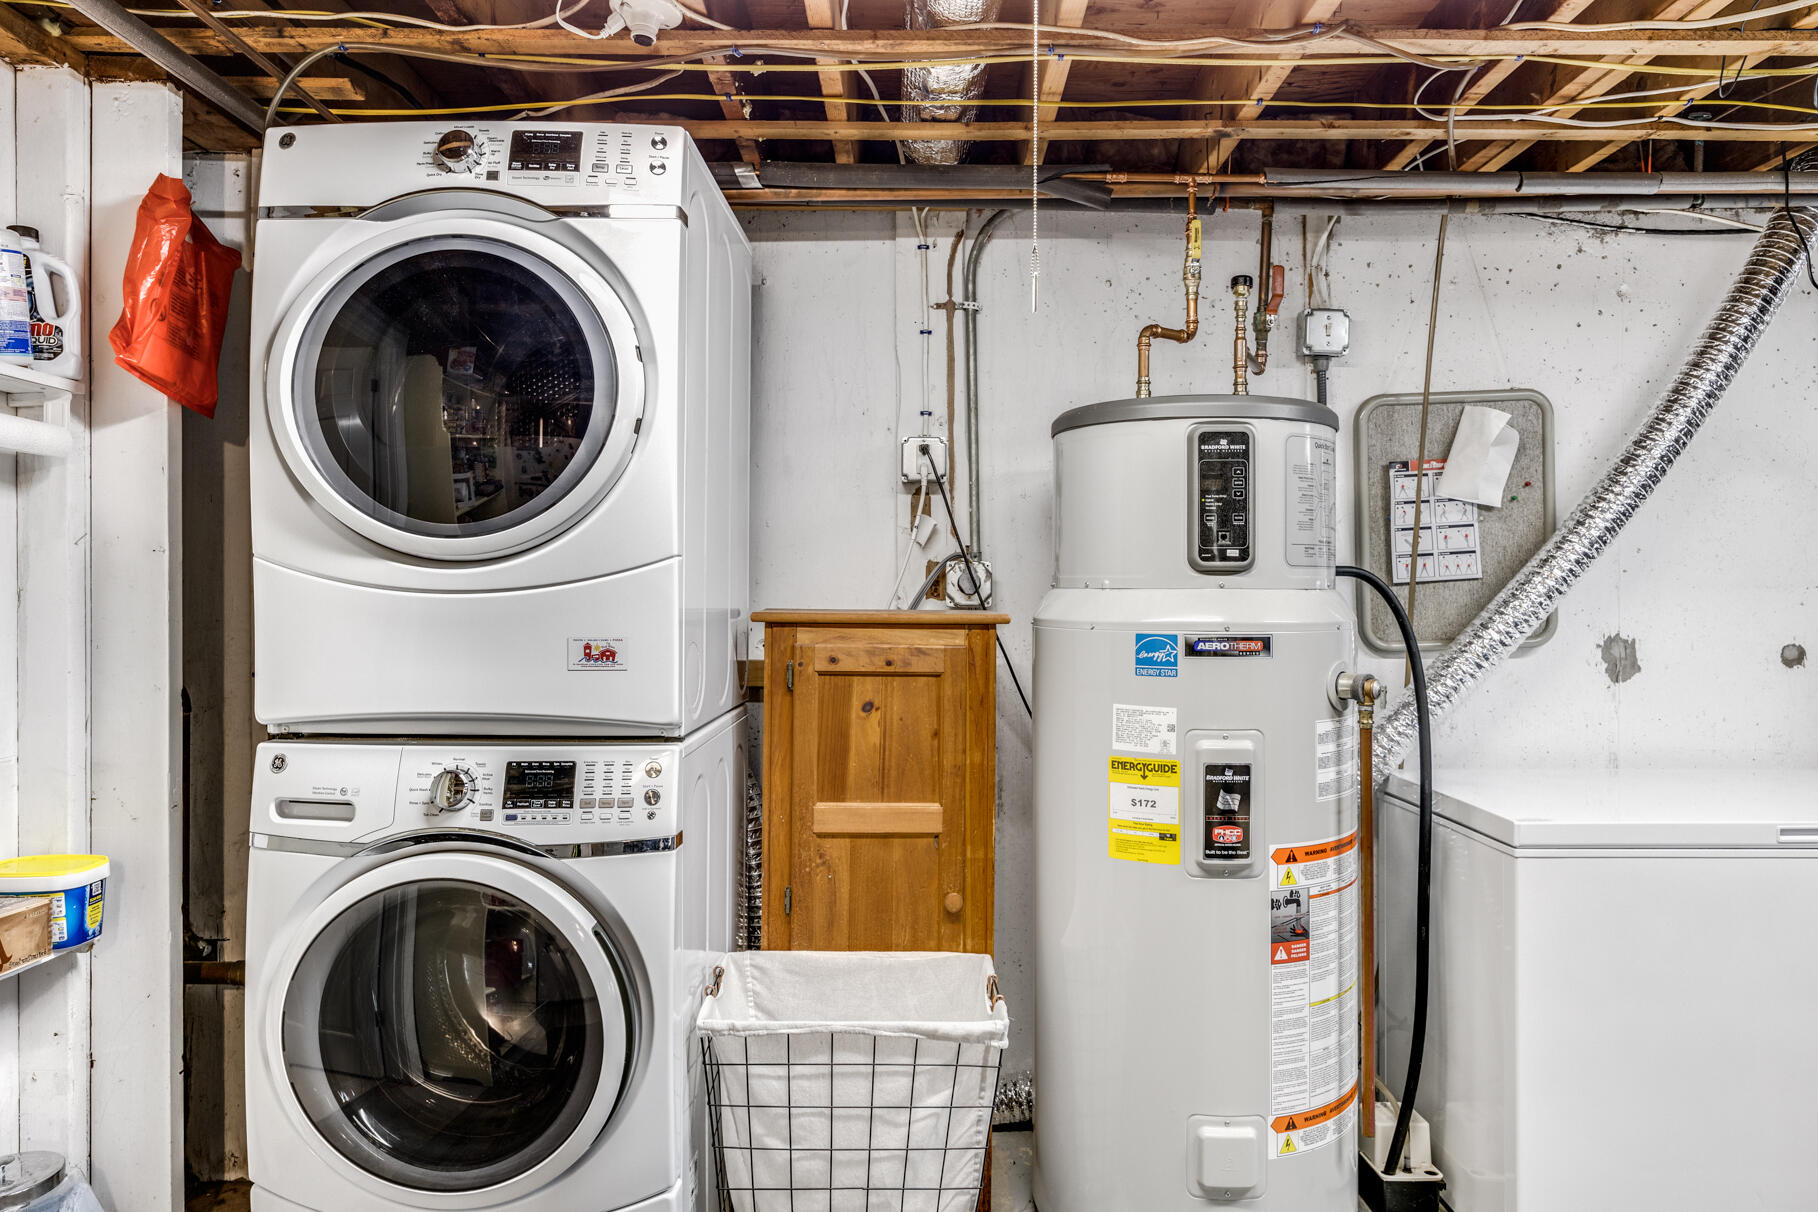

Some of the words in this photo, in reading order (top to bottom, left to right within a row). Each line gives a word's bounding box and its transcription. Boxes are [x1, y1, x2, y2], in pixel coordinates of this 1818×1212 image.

[1197, 641, 1261, 650] AEROTHERM
[1111, 760, 1177, 775] ENERGYGUIDE
[1131, 798, 1157, 808] $172
[1305, 848, 1327, 856] WARNING
[1304, 1111, 1327, 1122] WARNING
